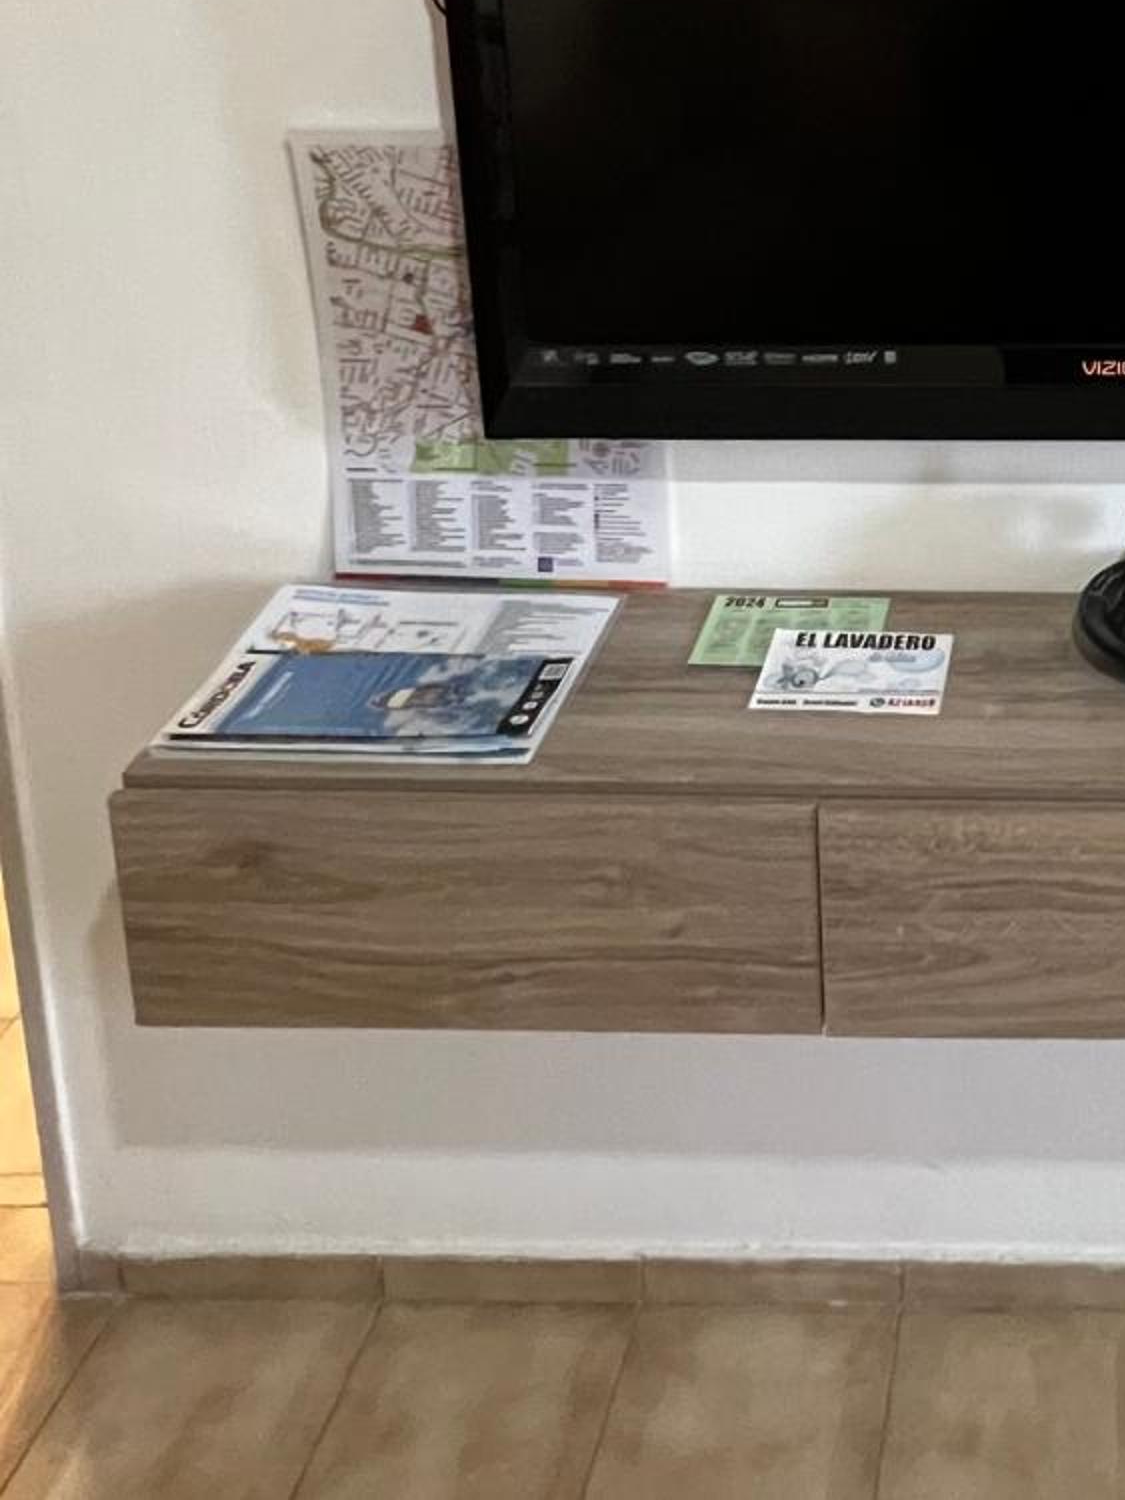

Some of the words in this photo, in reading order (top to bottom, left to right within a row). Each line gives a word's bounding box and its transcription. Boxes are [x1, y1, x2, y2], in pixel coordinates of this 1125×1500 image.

[724, 597, 766, 609] 2024
[795, 632, 817, 649] EL
[823, 633, 937, 651] LAVADERO
